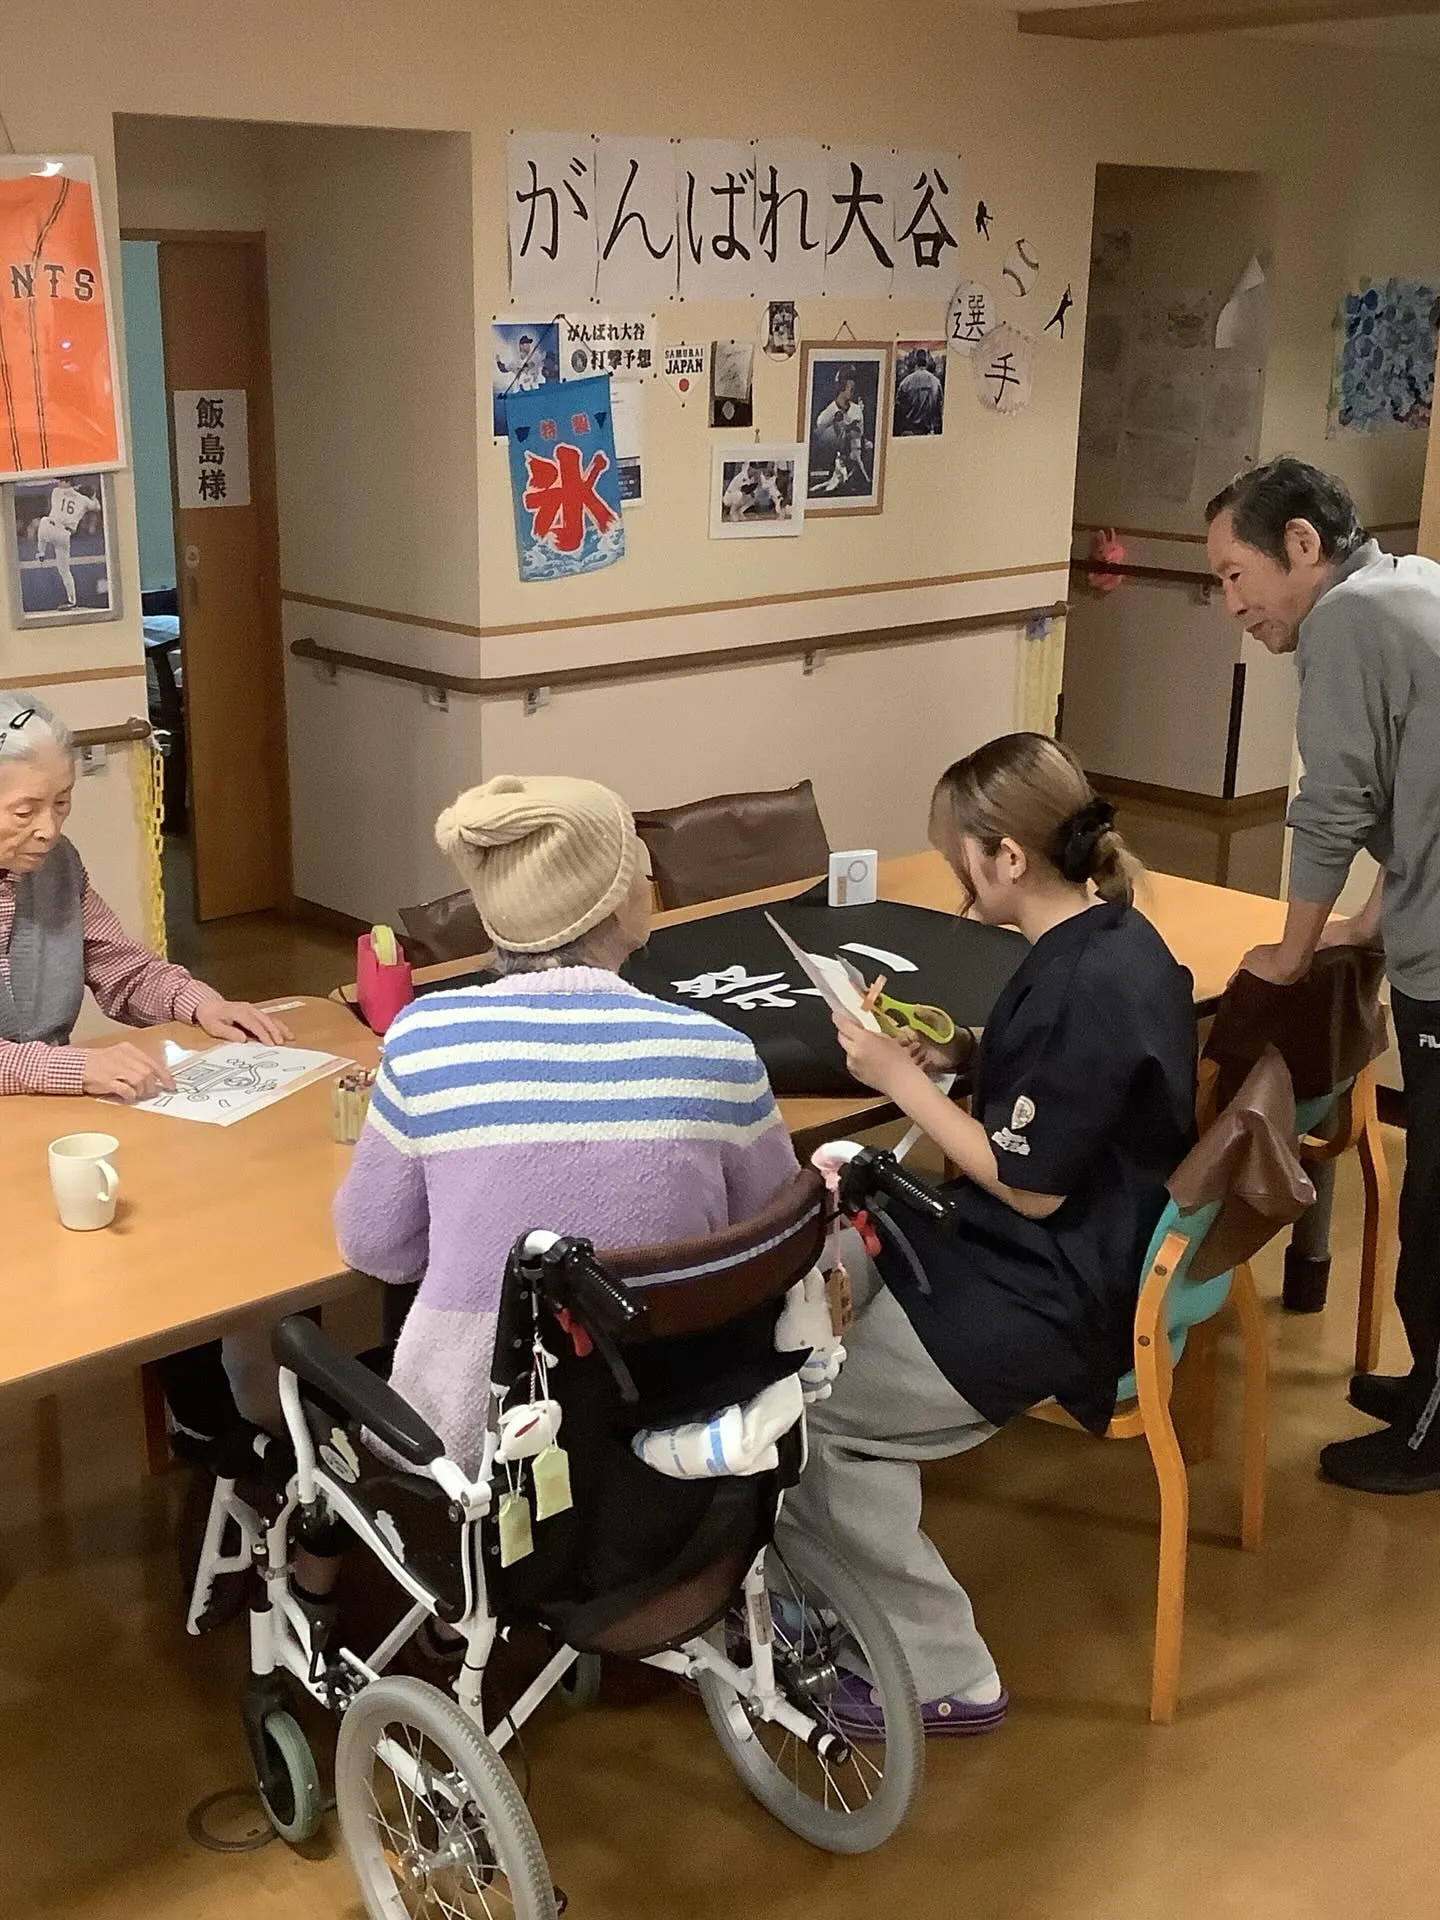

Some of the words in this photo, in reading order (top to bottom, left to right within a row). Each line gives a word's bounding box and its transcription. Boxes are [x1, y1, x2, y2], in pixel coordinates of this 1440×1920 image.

[516, 157, 958, 269] がんばれ大谷
[951, 294, 986, 342] 選
[664, 347, 704, 360] SAMURAI
[664, 358, 704, 375] JAPAN
[984, 352, 1020, 404] 手
[196, 397, 227, 501] 飯島様
[60, 498, 76, 515] 16
[523, 443, 619, 553] 氷
